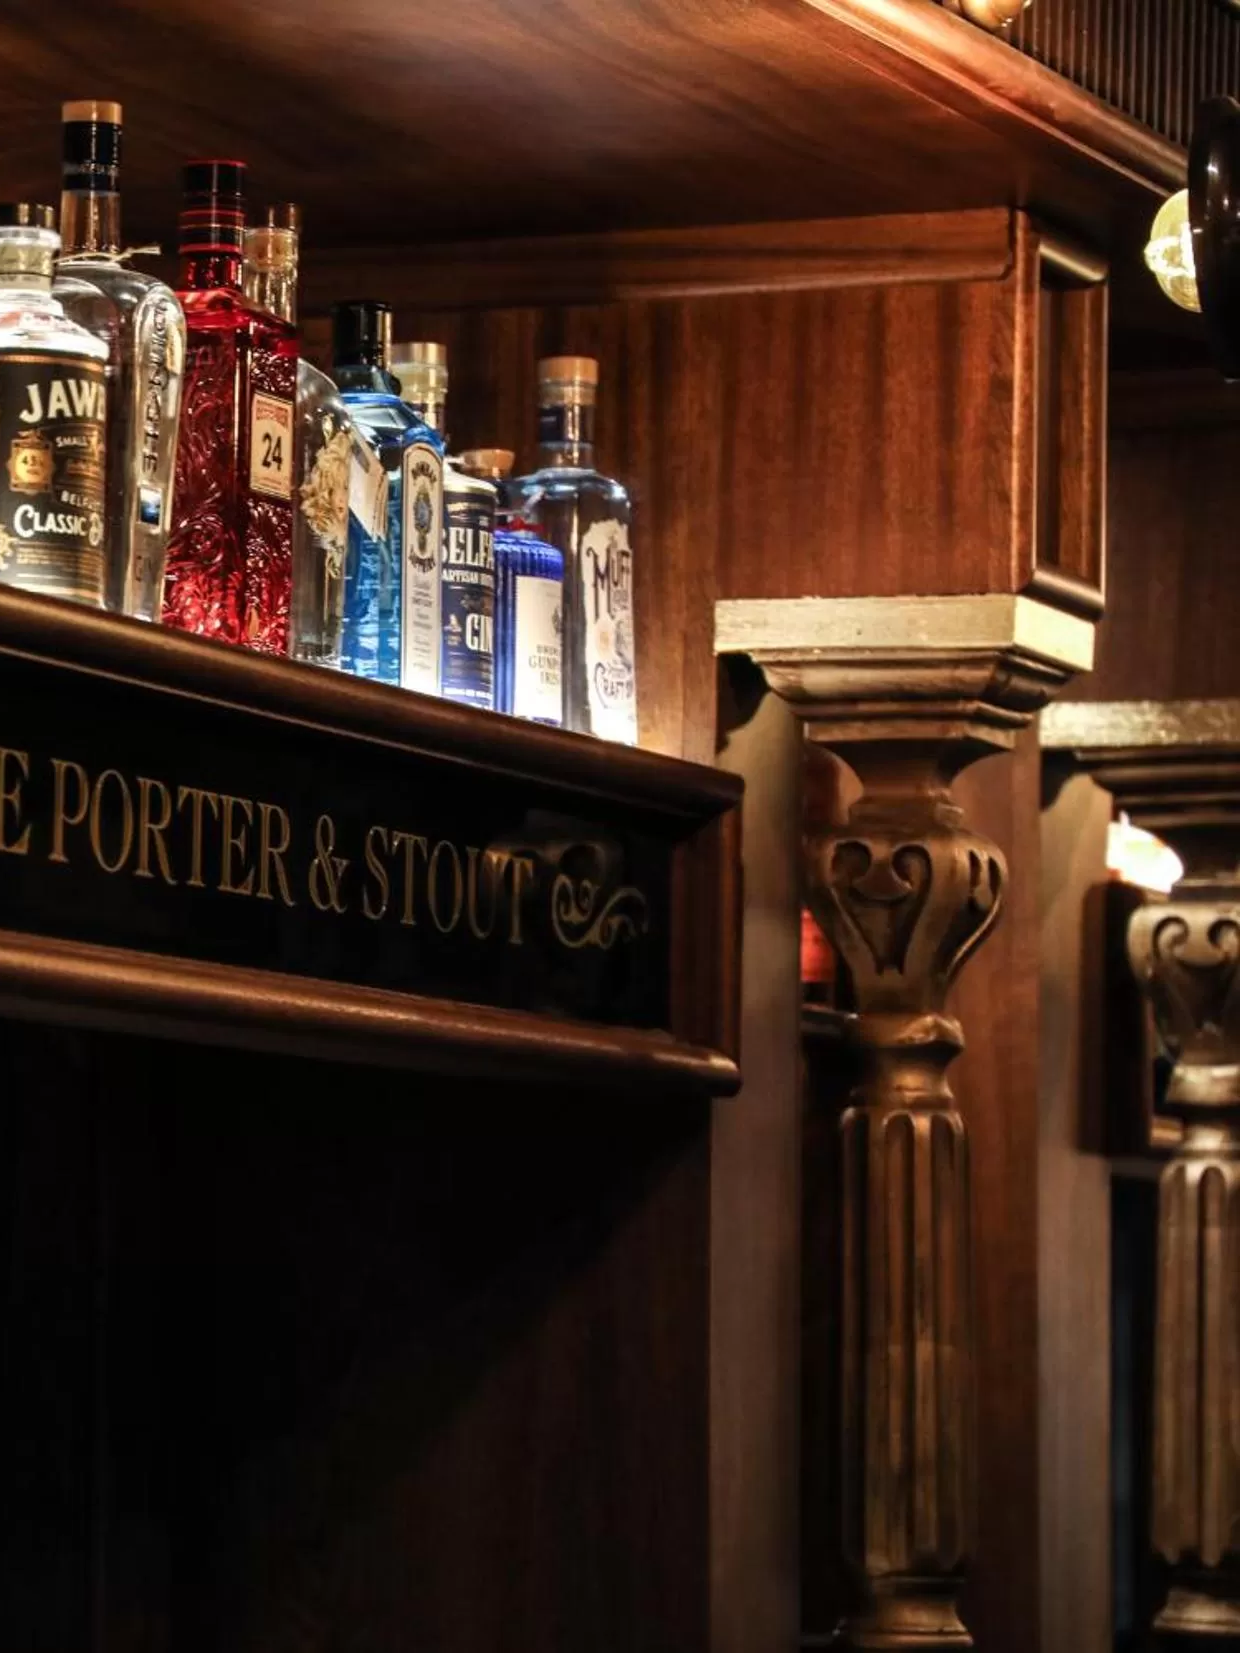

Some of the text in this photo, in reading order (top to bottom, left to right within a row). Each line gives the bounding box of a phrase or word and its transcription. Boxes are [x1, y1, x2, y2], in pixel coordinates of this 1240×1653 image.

[262, 432, 283, 472] 24
[48, 758, 296, 906] PORTER
[308, 813, 350, 915] &
[362, 825, 534, 945] STOUT
